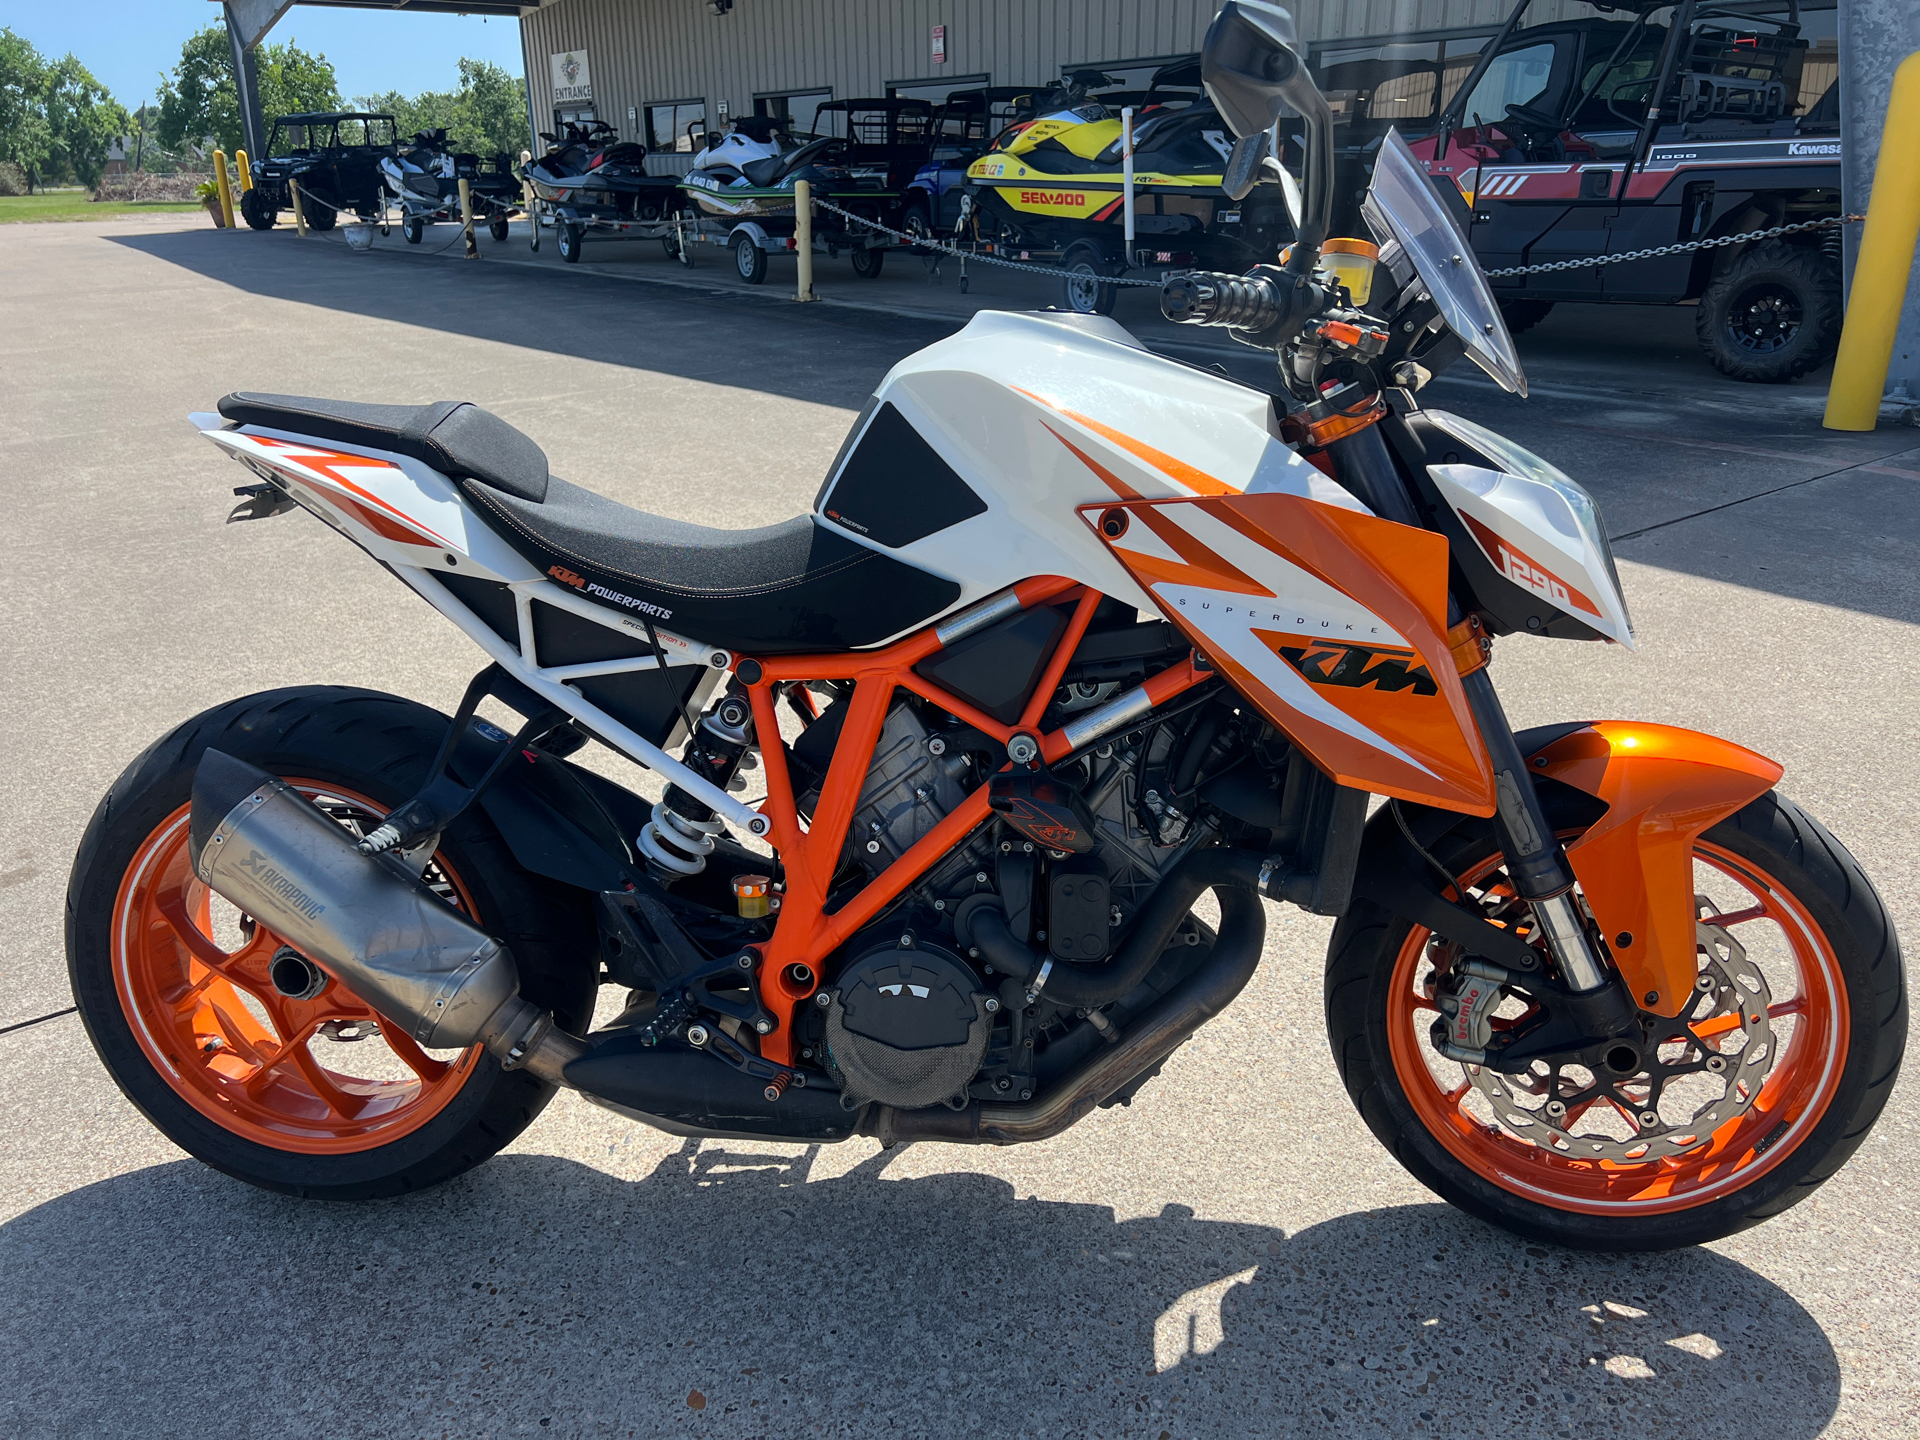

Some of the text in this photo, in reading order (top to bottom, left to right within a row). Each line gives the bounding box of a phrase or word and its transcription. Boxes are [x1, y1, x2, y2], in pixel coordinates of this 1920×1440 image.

[555, 85, 591, 99] ENTRANCE
[547, 565, 673, 620] KTM POWERPARTS
[1498, 544, 1572, 606] 1290
[1278, 640, 1438, 697] KTM
[1455, 989, 1479, 1040] brembo
